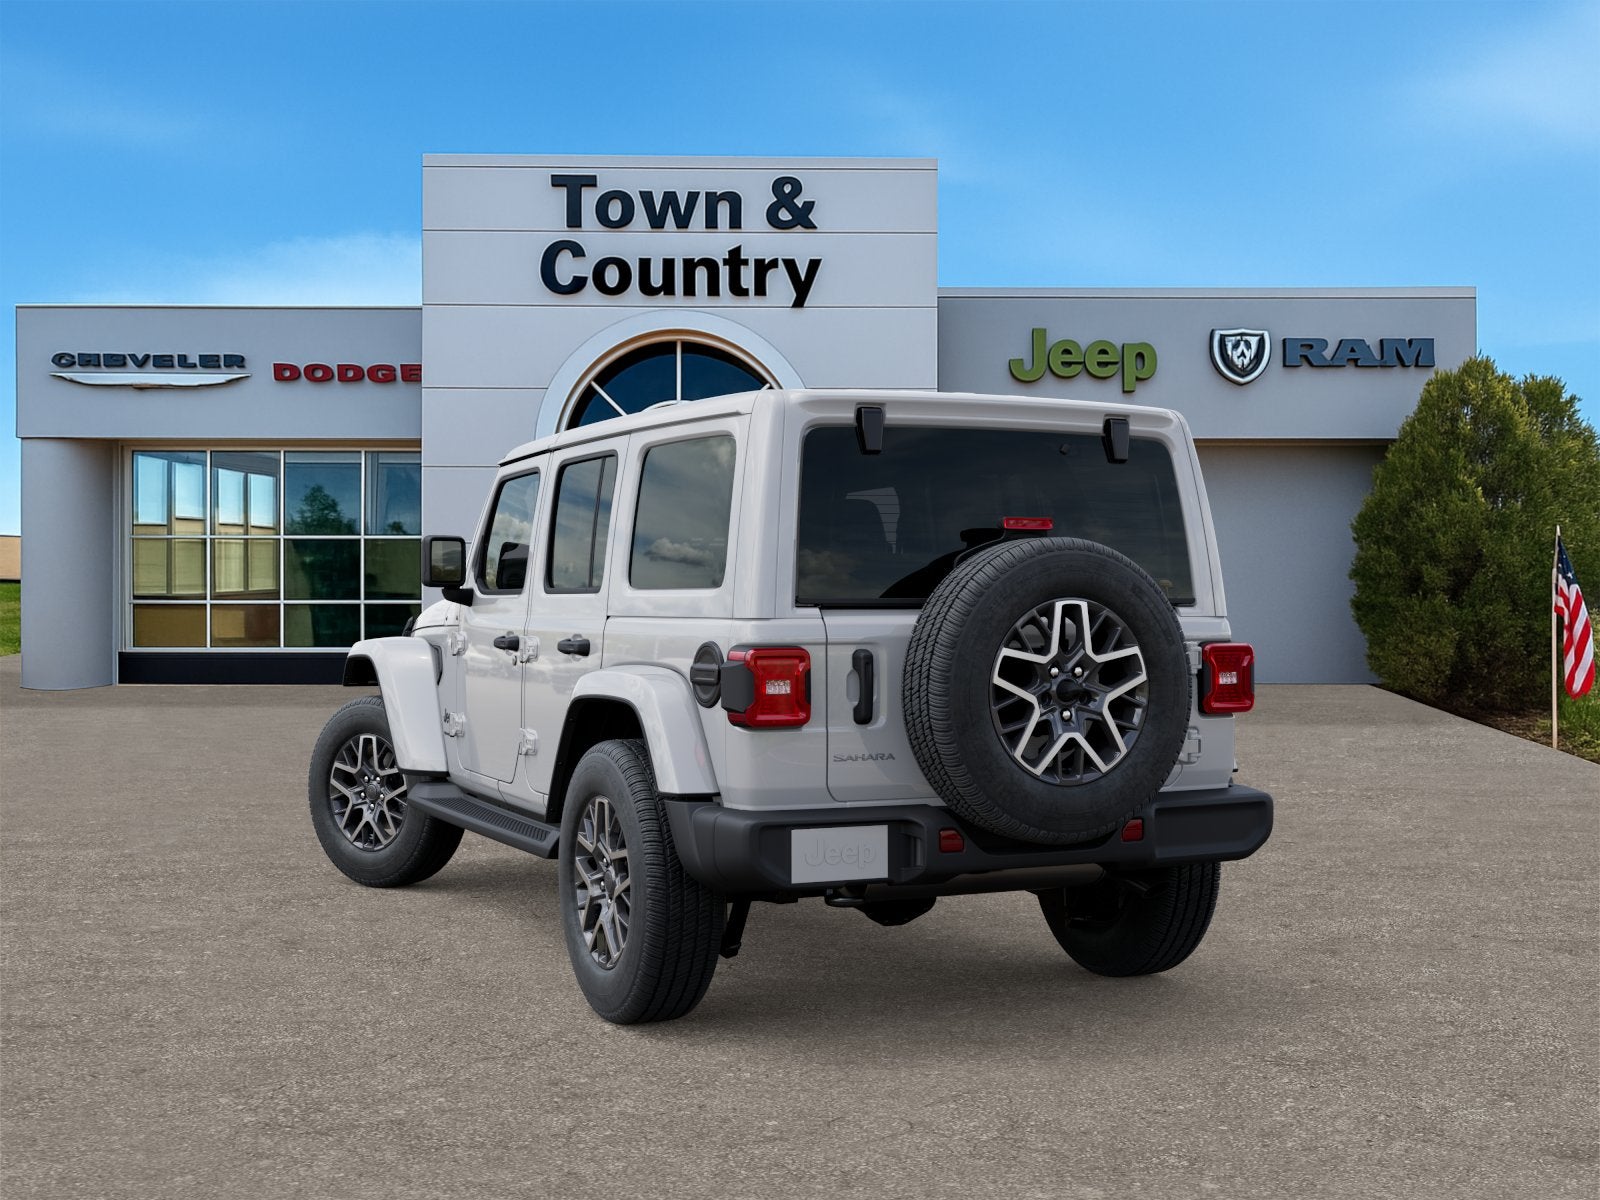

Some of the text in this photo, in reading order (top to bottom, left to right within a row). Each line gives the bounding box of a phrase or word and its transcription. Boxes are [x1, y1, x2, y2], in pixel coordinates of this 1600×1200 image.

[551, 174, 818, 230] Town &
[540, 239, 823, 308] Country
[1009, 327, 1158, 393] Jeep
[1282, 337, 1436, 368] RAM
[273, 363, 422, 383] DODGE
[832, 752, 896, 763] SAHARA
[804, 838, 877, 870] Jeep
